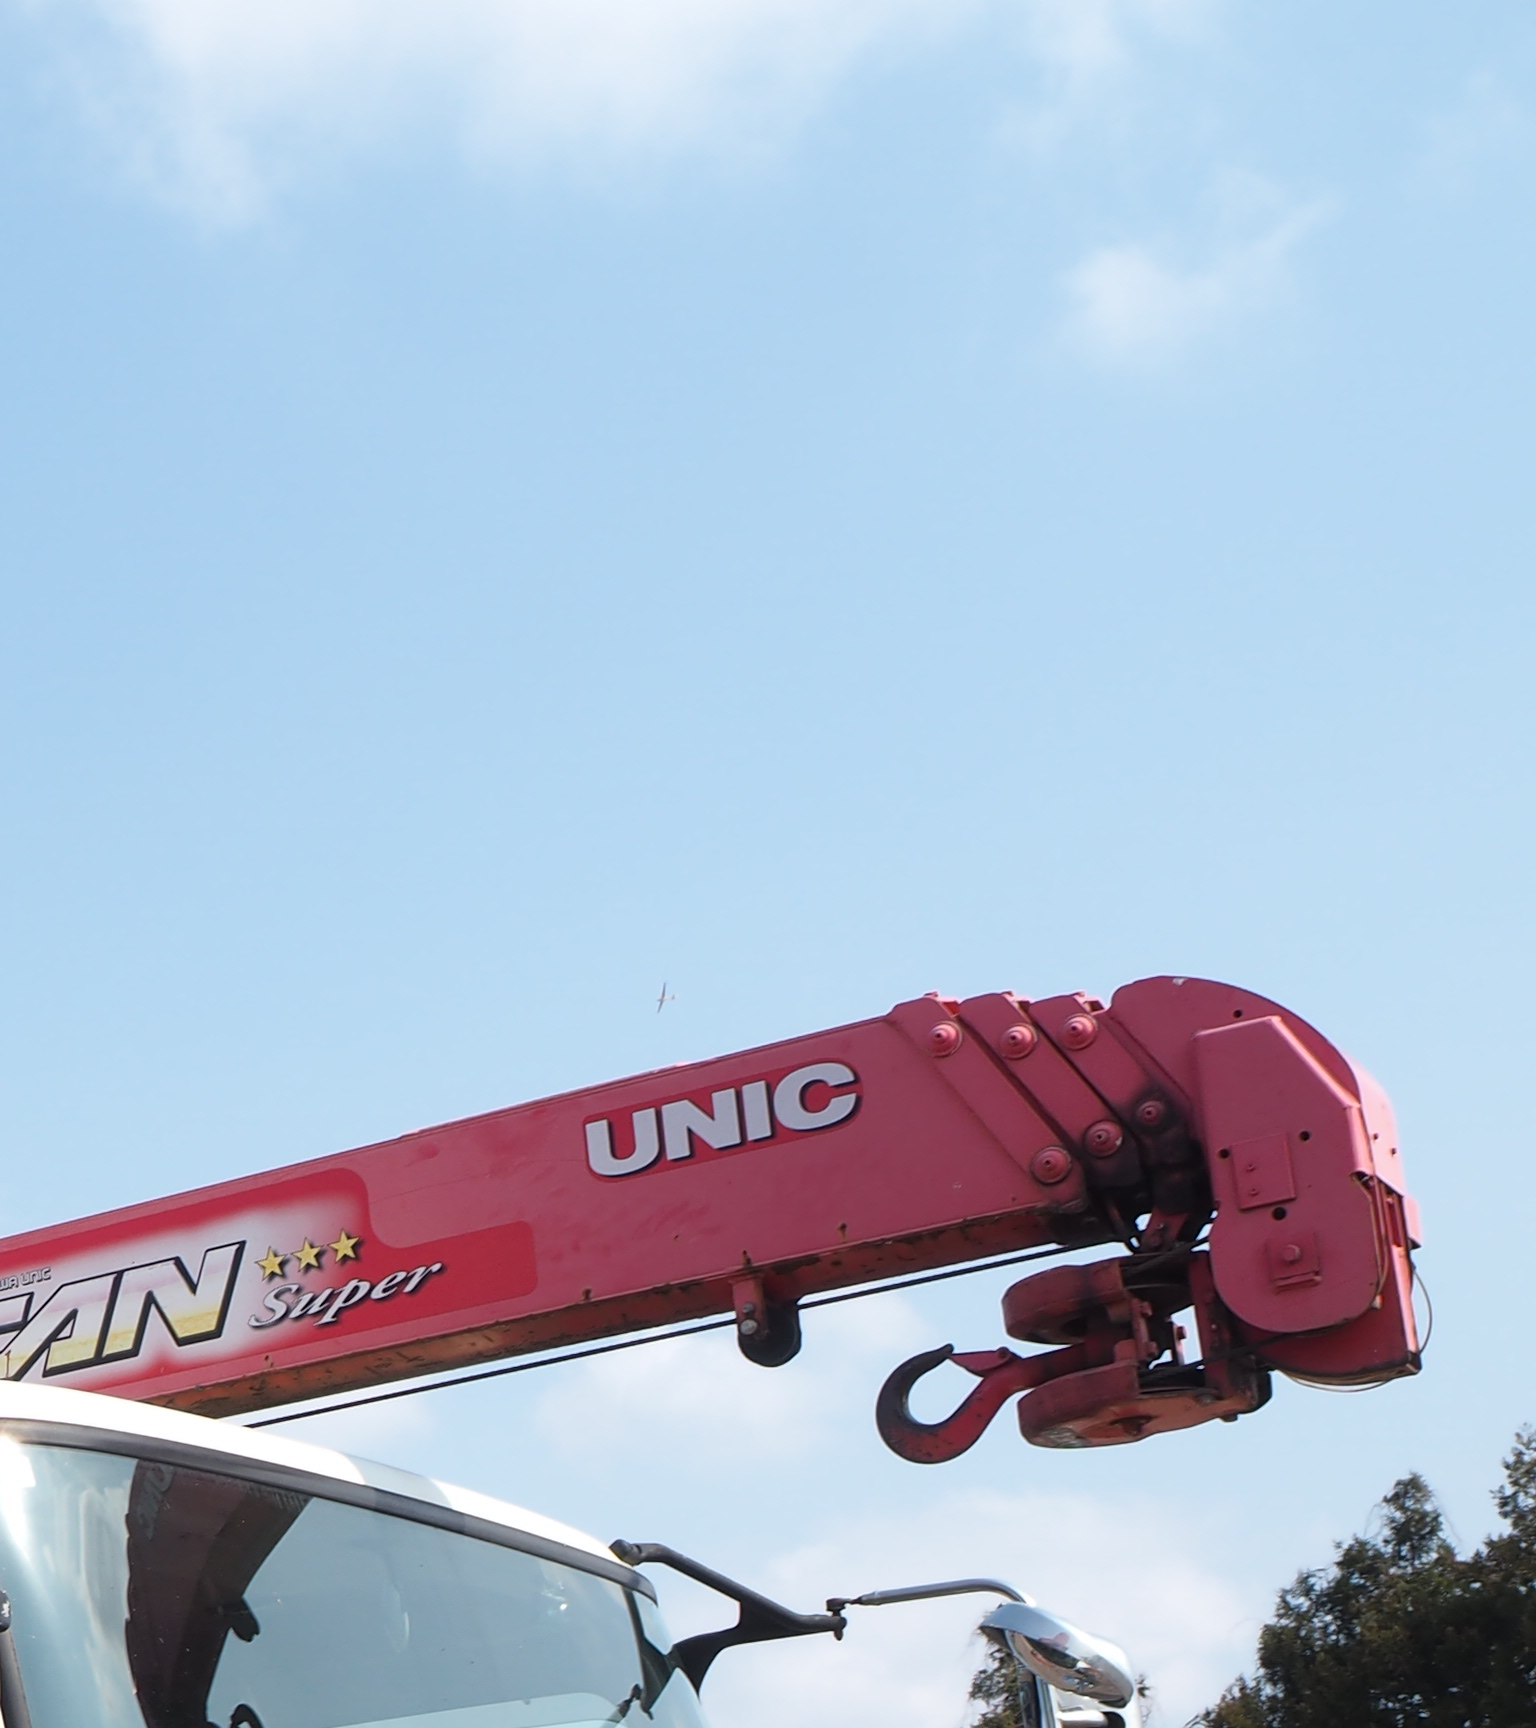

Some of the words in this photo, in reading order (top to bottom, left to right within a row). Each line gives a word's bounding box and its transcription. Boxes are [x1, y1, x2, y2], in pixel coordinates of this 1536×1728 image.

[585, 1060, 860, 1180] UNIC
[20, 1267, 52, 1286] UNIC
[247, 1259, 444, 1329] Super
